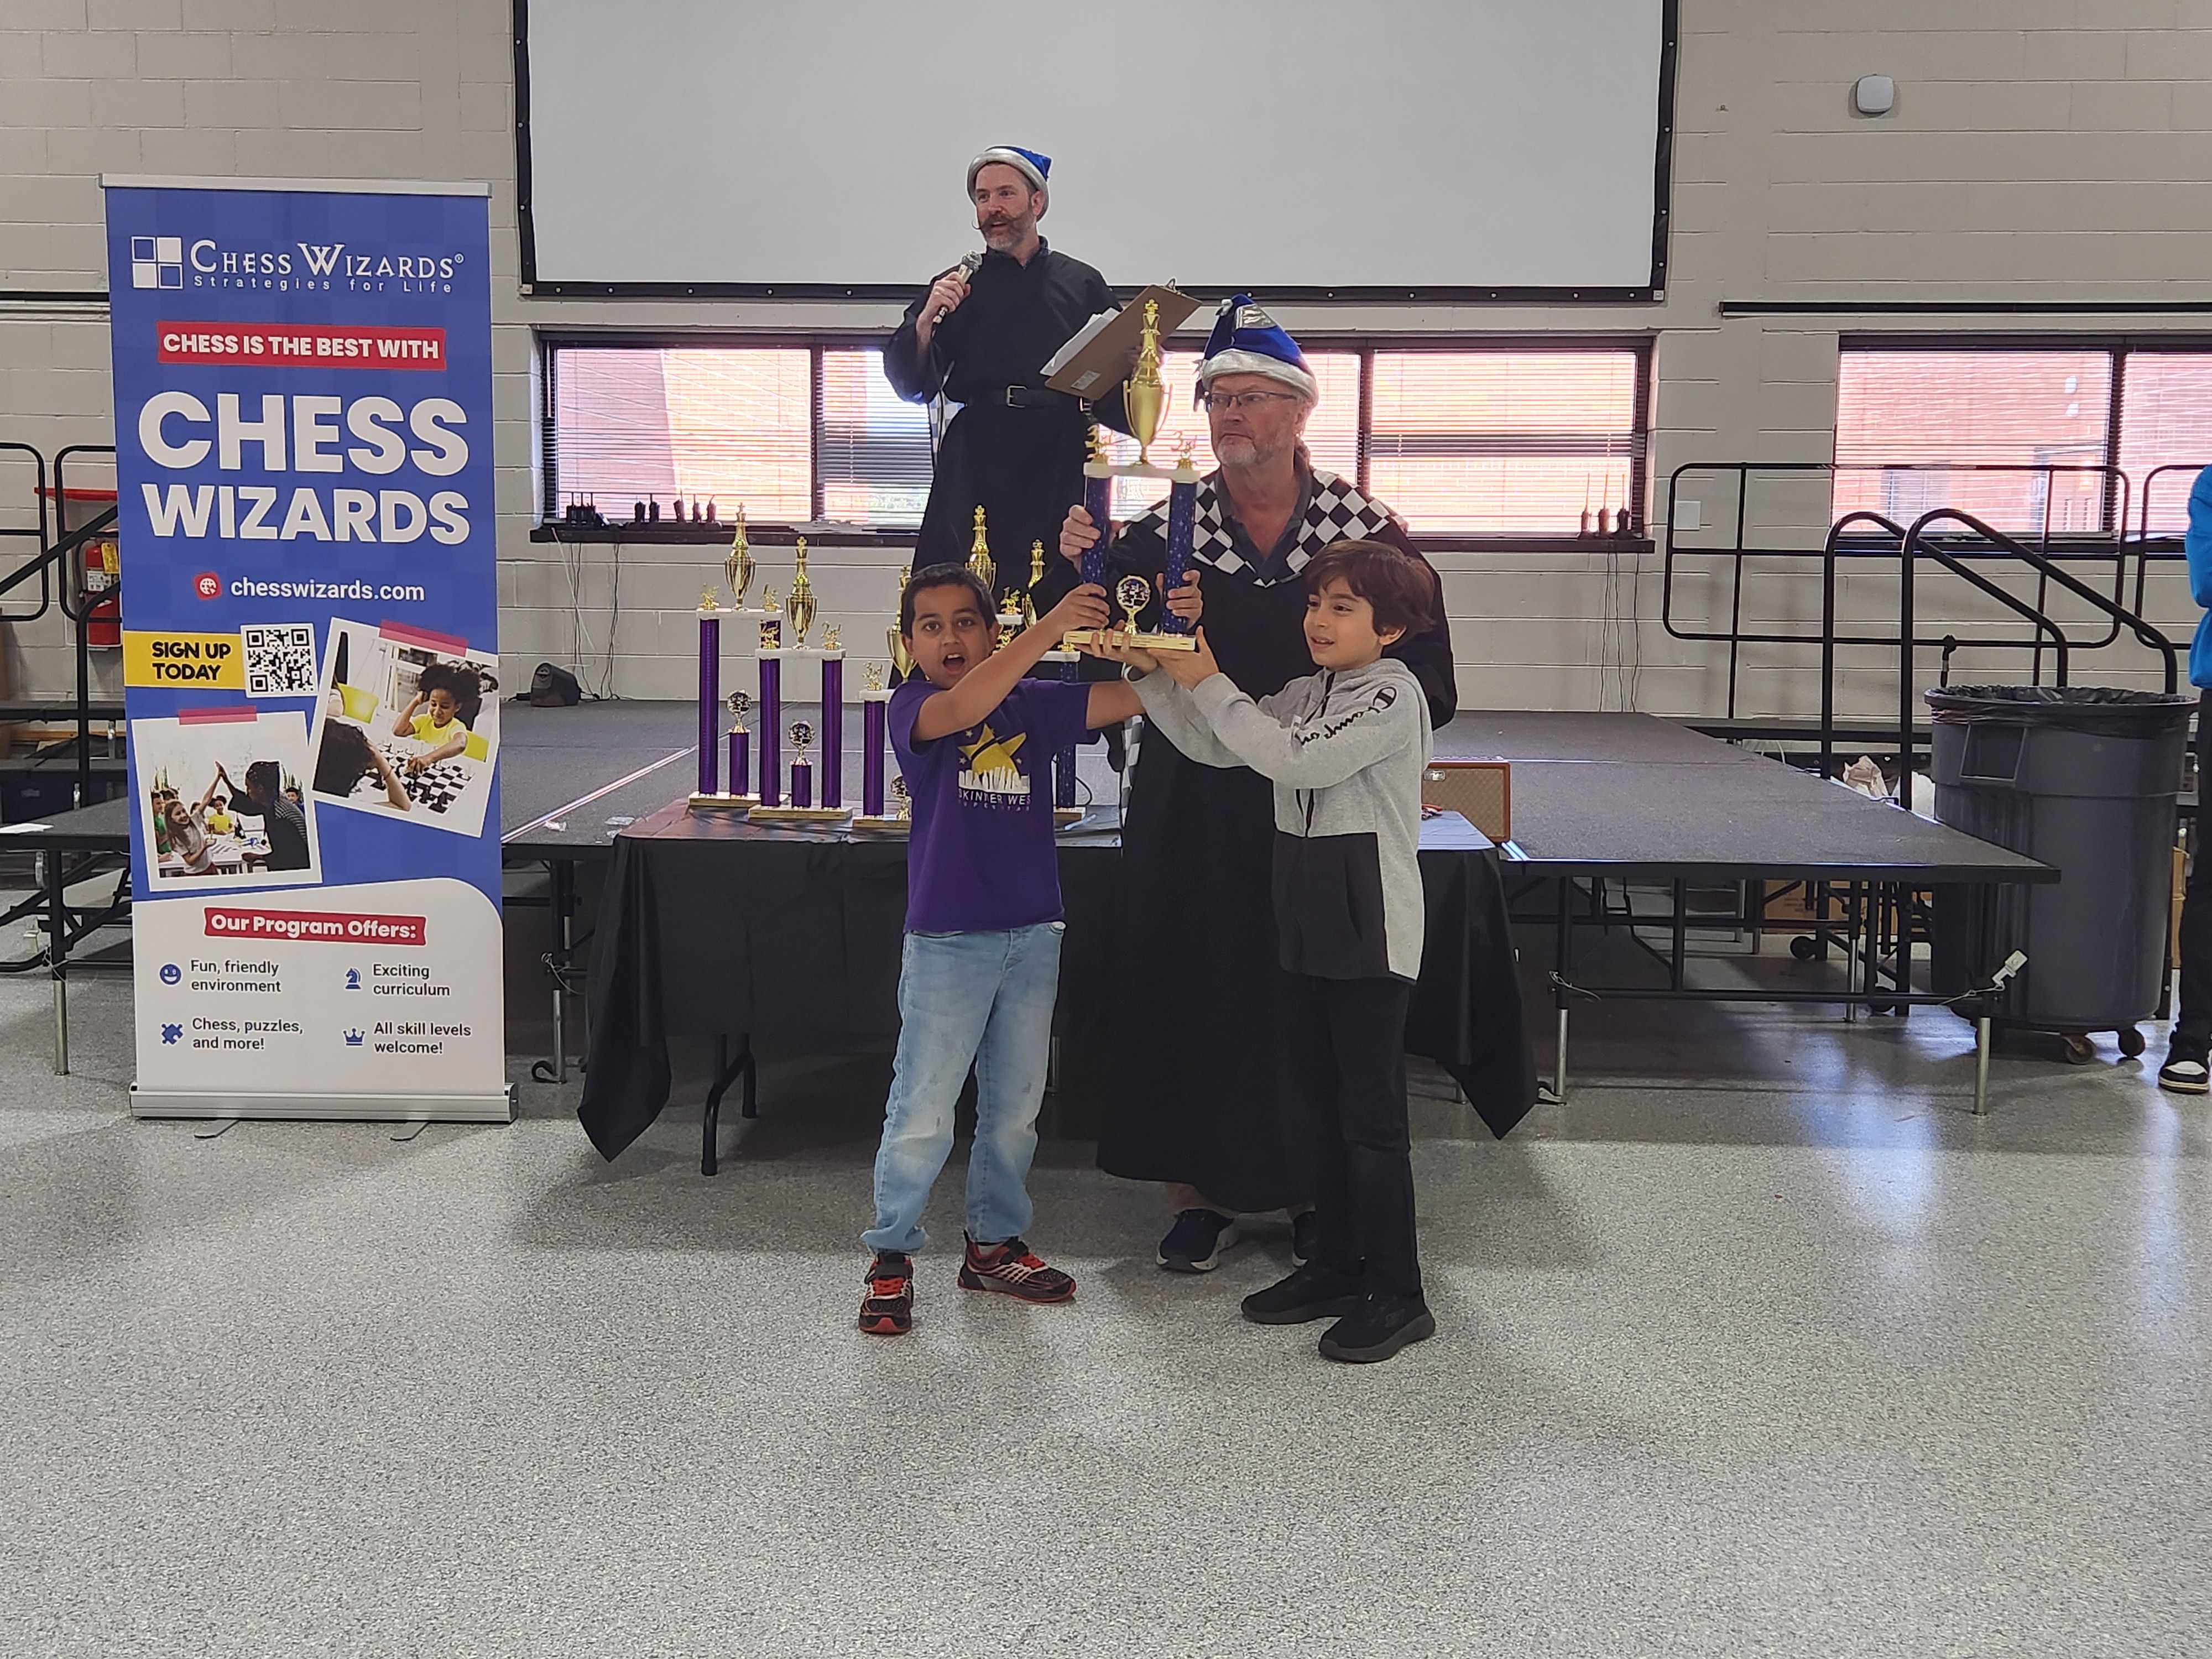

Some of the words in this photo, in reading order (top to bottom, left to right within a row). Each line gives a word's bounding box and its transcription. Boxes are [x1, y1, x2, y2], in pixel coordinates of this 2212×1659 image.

[194, 275, 331, 291] Strategies
[349, 279, 384, 291] for
[403, 280, 451, 293] Life
[164, 334, 238, 353] CHESS
[243, 336, 264, 354] IS
[268, 336, 312, 355] THE
[317, 338, 372, 357] BEST
[377, 339, 439, 358] WITH
[138, 391, 469, 476] CHESS
[142, 483, 470, 545] WIZARDS
[231, 577, 425, 601] chesswizards.com
[152, 641, 200, 659] SIGN
[205, 643, 231, 659] UP
[152, 663, 221, 680] TODAY
[1295, 686, 1397, 746] Champon
[211, 915, 249, 931] Our
[253, 916, 343, 938] Program
[348, 920, 416, 938] Offers:
[191, 960, 221, 974] Fun,
[225, 960, 279, 977] friendly
[373, 964, 430, 980] Exciting
[191, 978, 281, 992] environment
[373, 983, 450, 996] curriculum
[192, 1018, 240, 1033] Chess,
[244, 1019, 303, 1035] puzzles,
[374, 1022, 393, 1034] All
[397, 1022, 426, 1035] skill
[431, 1022, 471, 1036] levels
[193, 1036, 219, 1048] and
[223, 1038, 264, 1050] more!
[374, 1040, 443, 1054] welcome!
